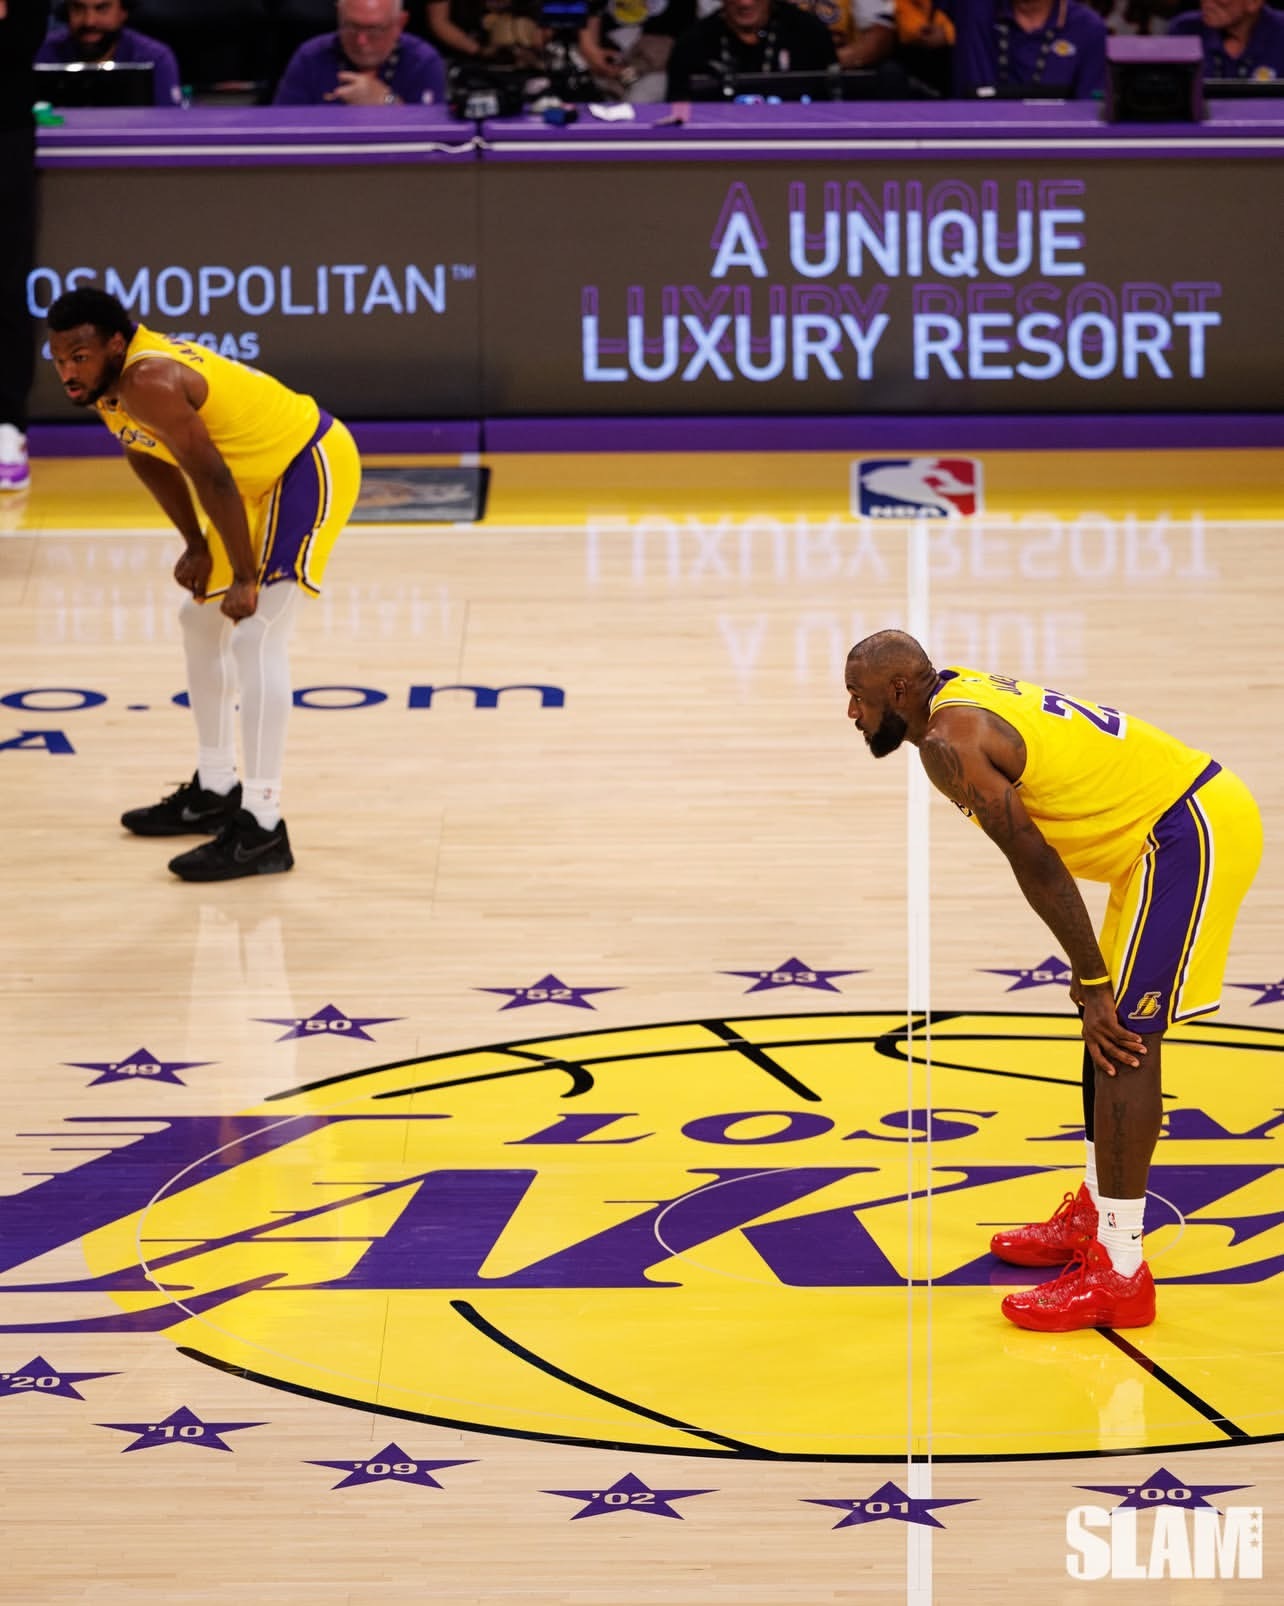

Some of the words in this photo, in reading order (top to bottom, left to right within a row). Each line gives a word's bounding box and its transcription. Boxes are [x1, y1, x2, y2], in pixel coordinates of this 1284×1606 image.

[710, 211, 769, 278] A
[788, 208, 1086, 278] UNIQUE
[582, 313, 891, 382] LUXURY
[913, 310, 1222, 381] RESORT
[1042, 688, 1127, 740] 2
[759, 971, 818, 983] '53
[515, 988, 574, 1001] '52
[295, 1019, 353, 1032] '50
[108, 1063, 162, 1076] '49
[503, 1107, 999, 1145] LOS
[1, 1374, 61, 1389] '20
[147, 1425, 205, 1439] '10
[353, 1462, 418, 1476] '09
[591, 1491, 656, 1506] '02
[1127, 1487, 1193, 1501] '00
[852, 1501, 910, 1515] '01
